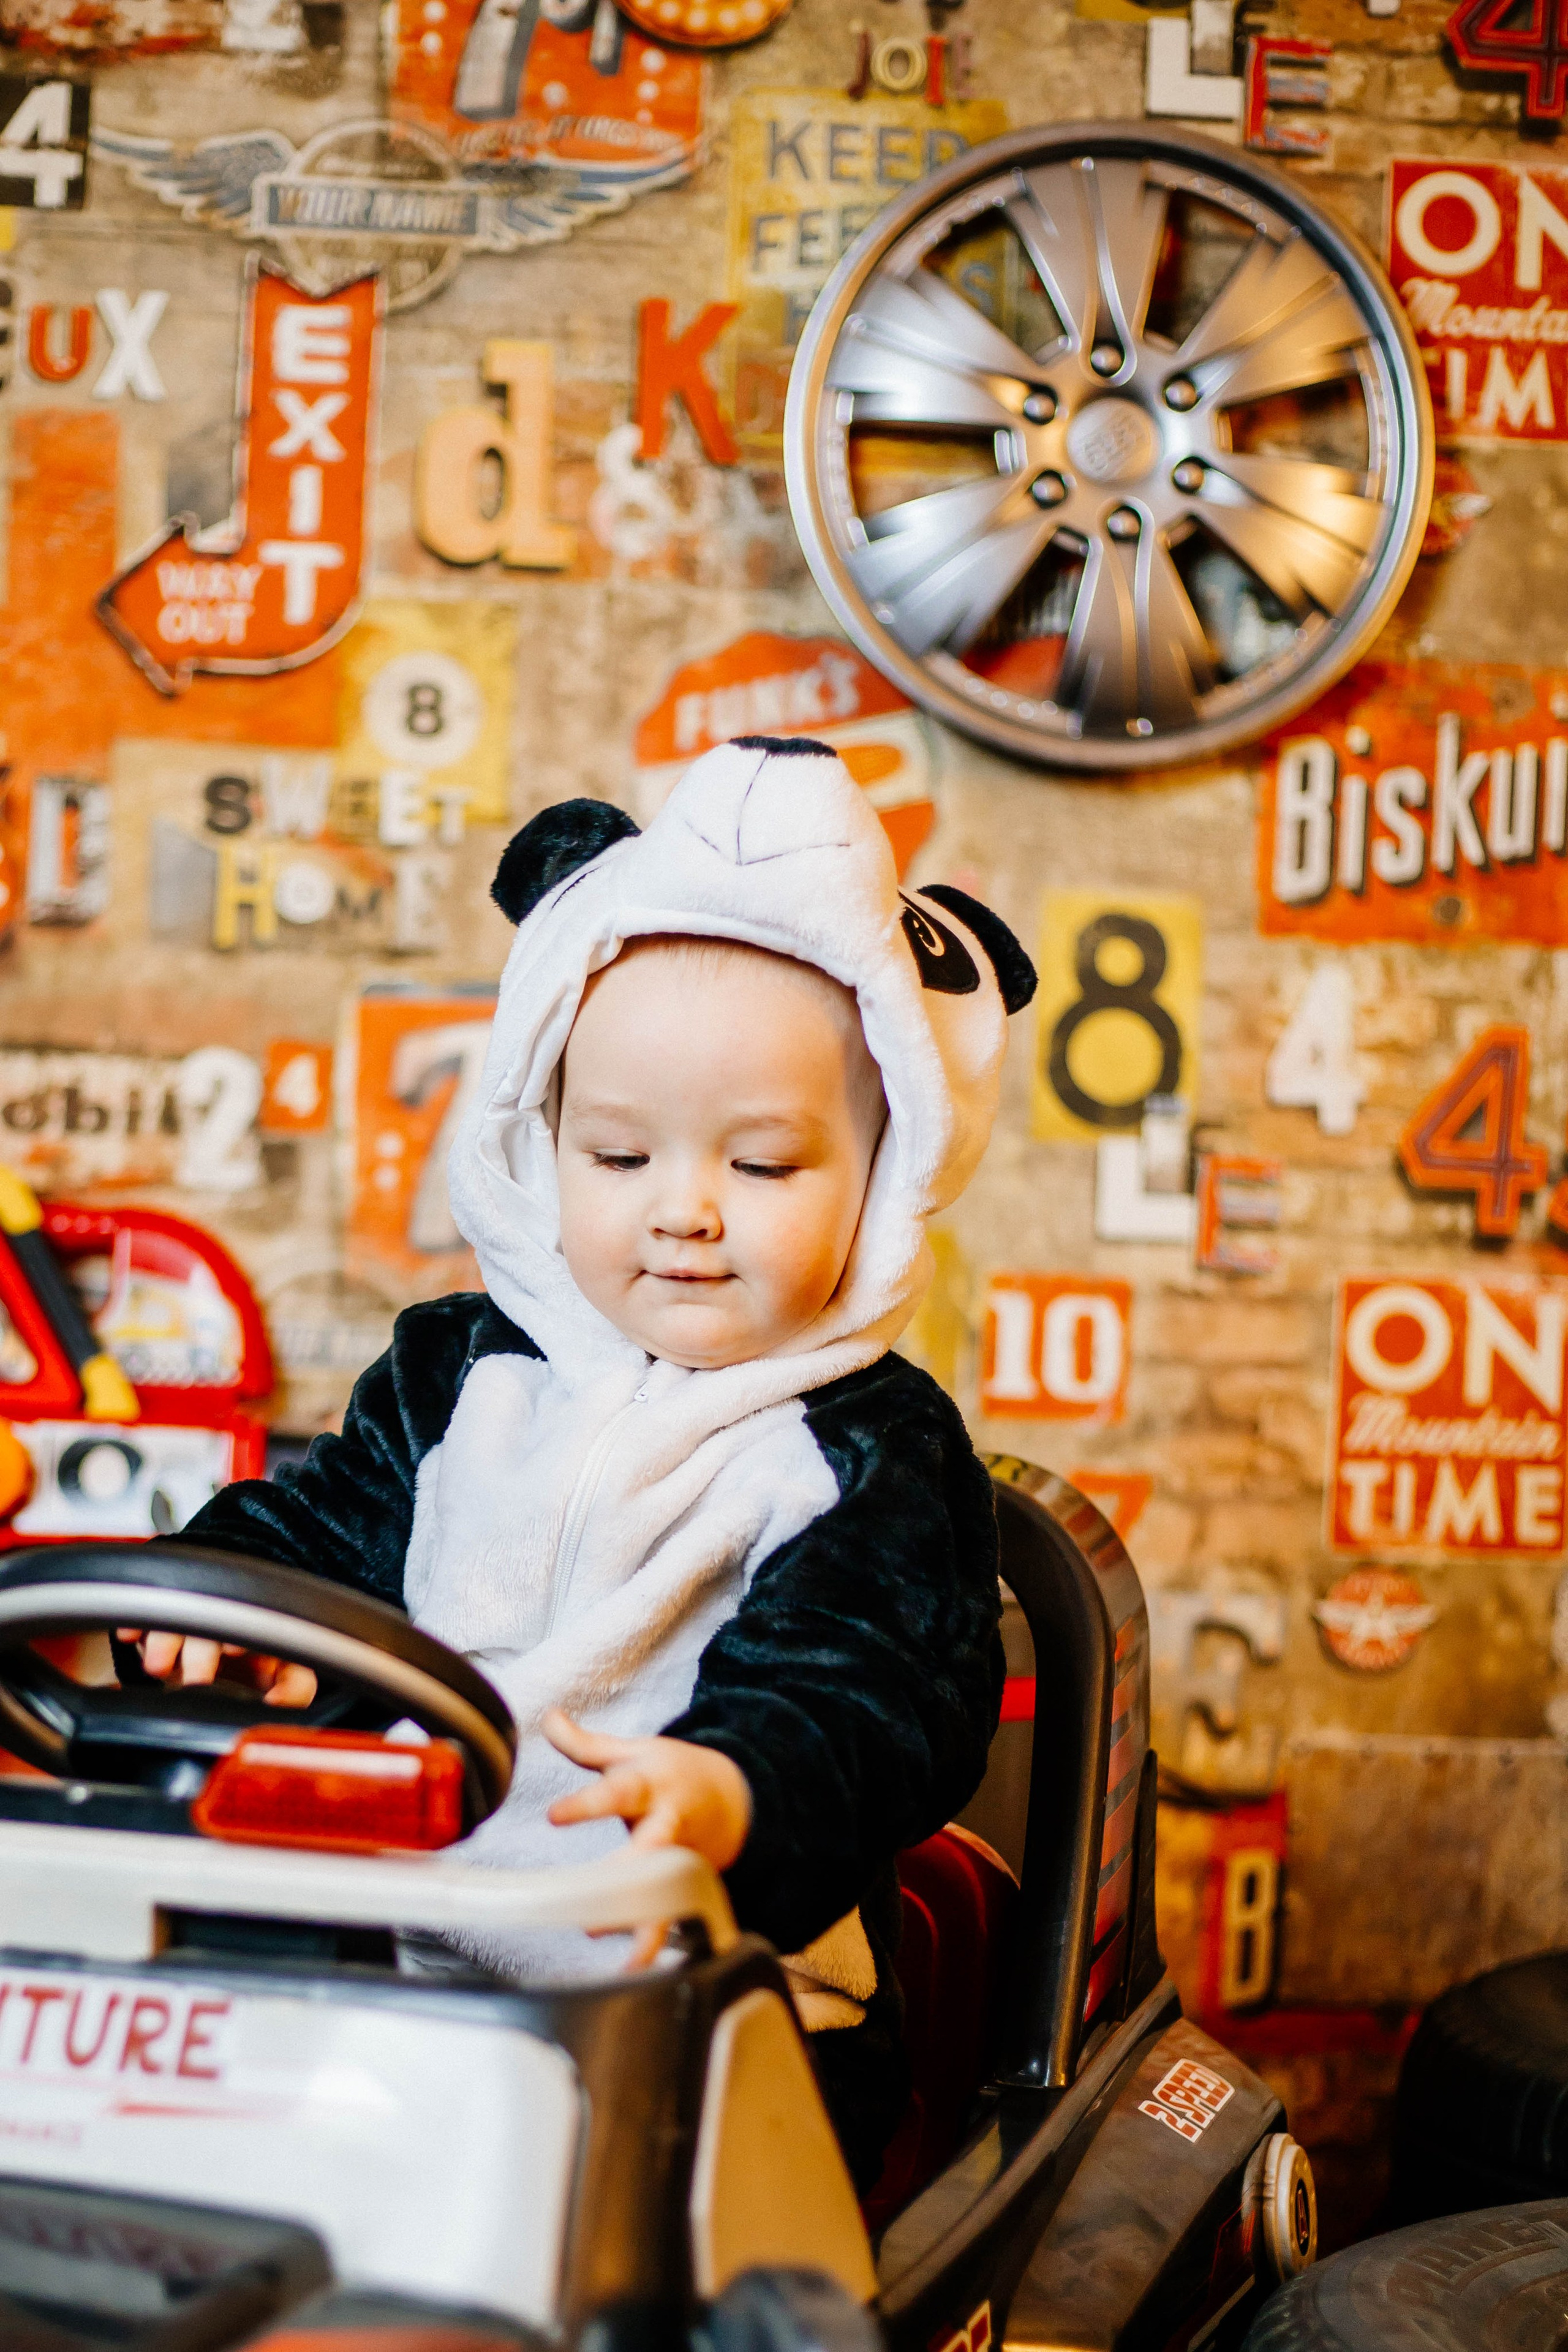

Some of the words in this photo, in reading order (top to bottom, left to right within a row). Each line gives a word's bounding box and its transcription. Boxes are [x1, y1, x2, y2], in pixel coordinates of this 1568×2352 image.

[0, 81, 83, 207] 4
[263, 306, 352, 626] EXIT
[157, 562, 262, 601] WAY
[157, 603, 252, 644] OUT
[405, 681, 445, 737] 8
[1049, 913, 1182, 1127] 8
[178, 1046, 263, 1189] 2
[1400, 1023, 1548, 1236] 4
[984, 1291, 1125, 1403] 10
[1346, 1283, 1565, 1416] ON
[1341, 1455, 1562, 1545] TIME
[0, 1983, 234, 2080] TURE
